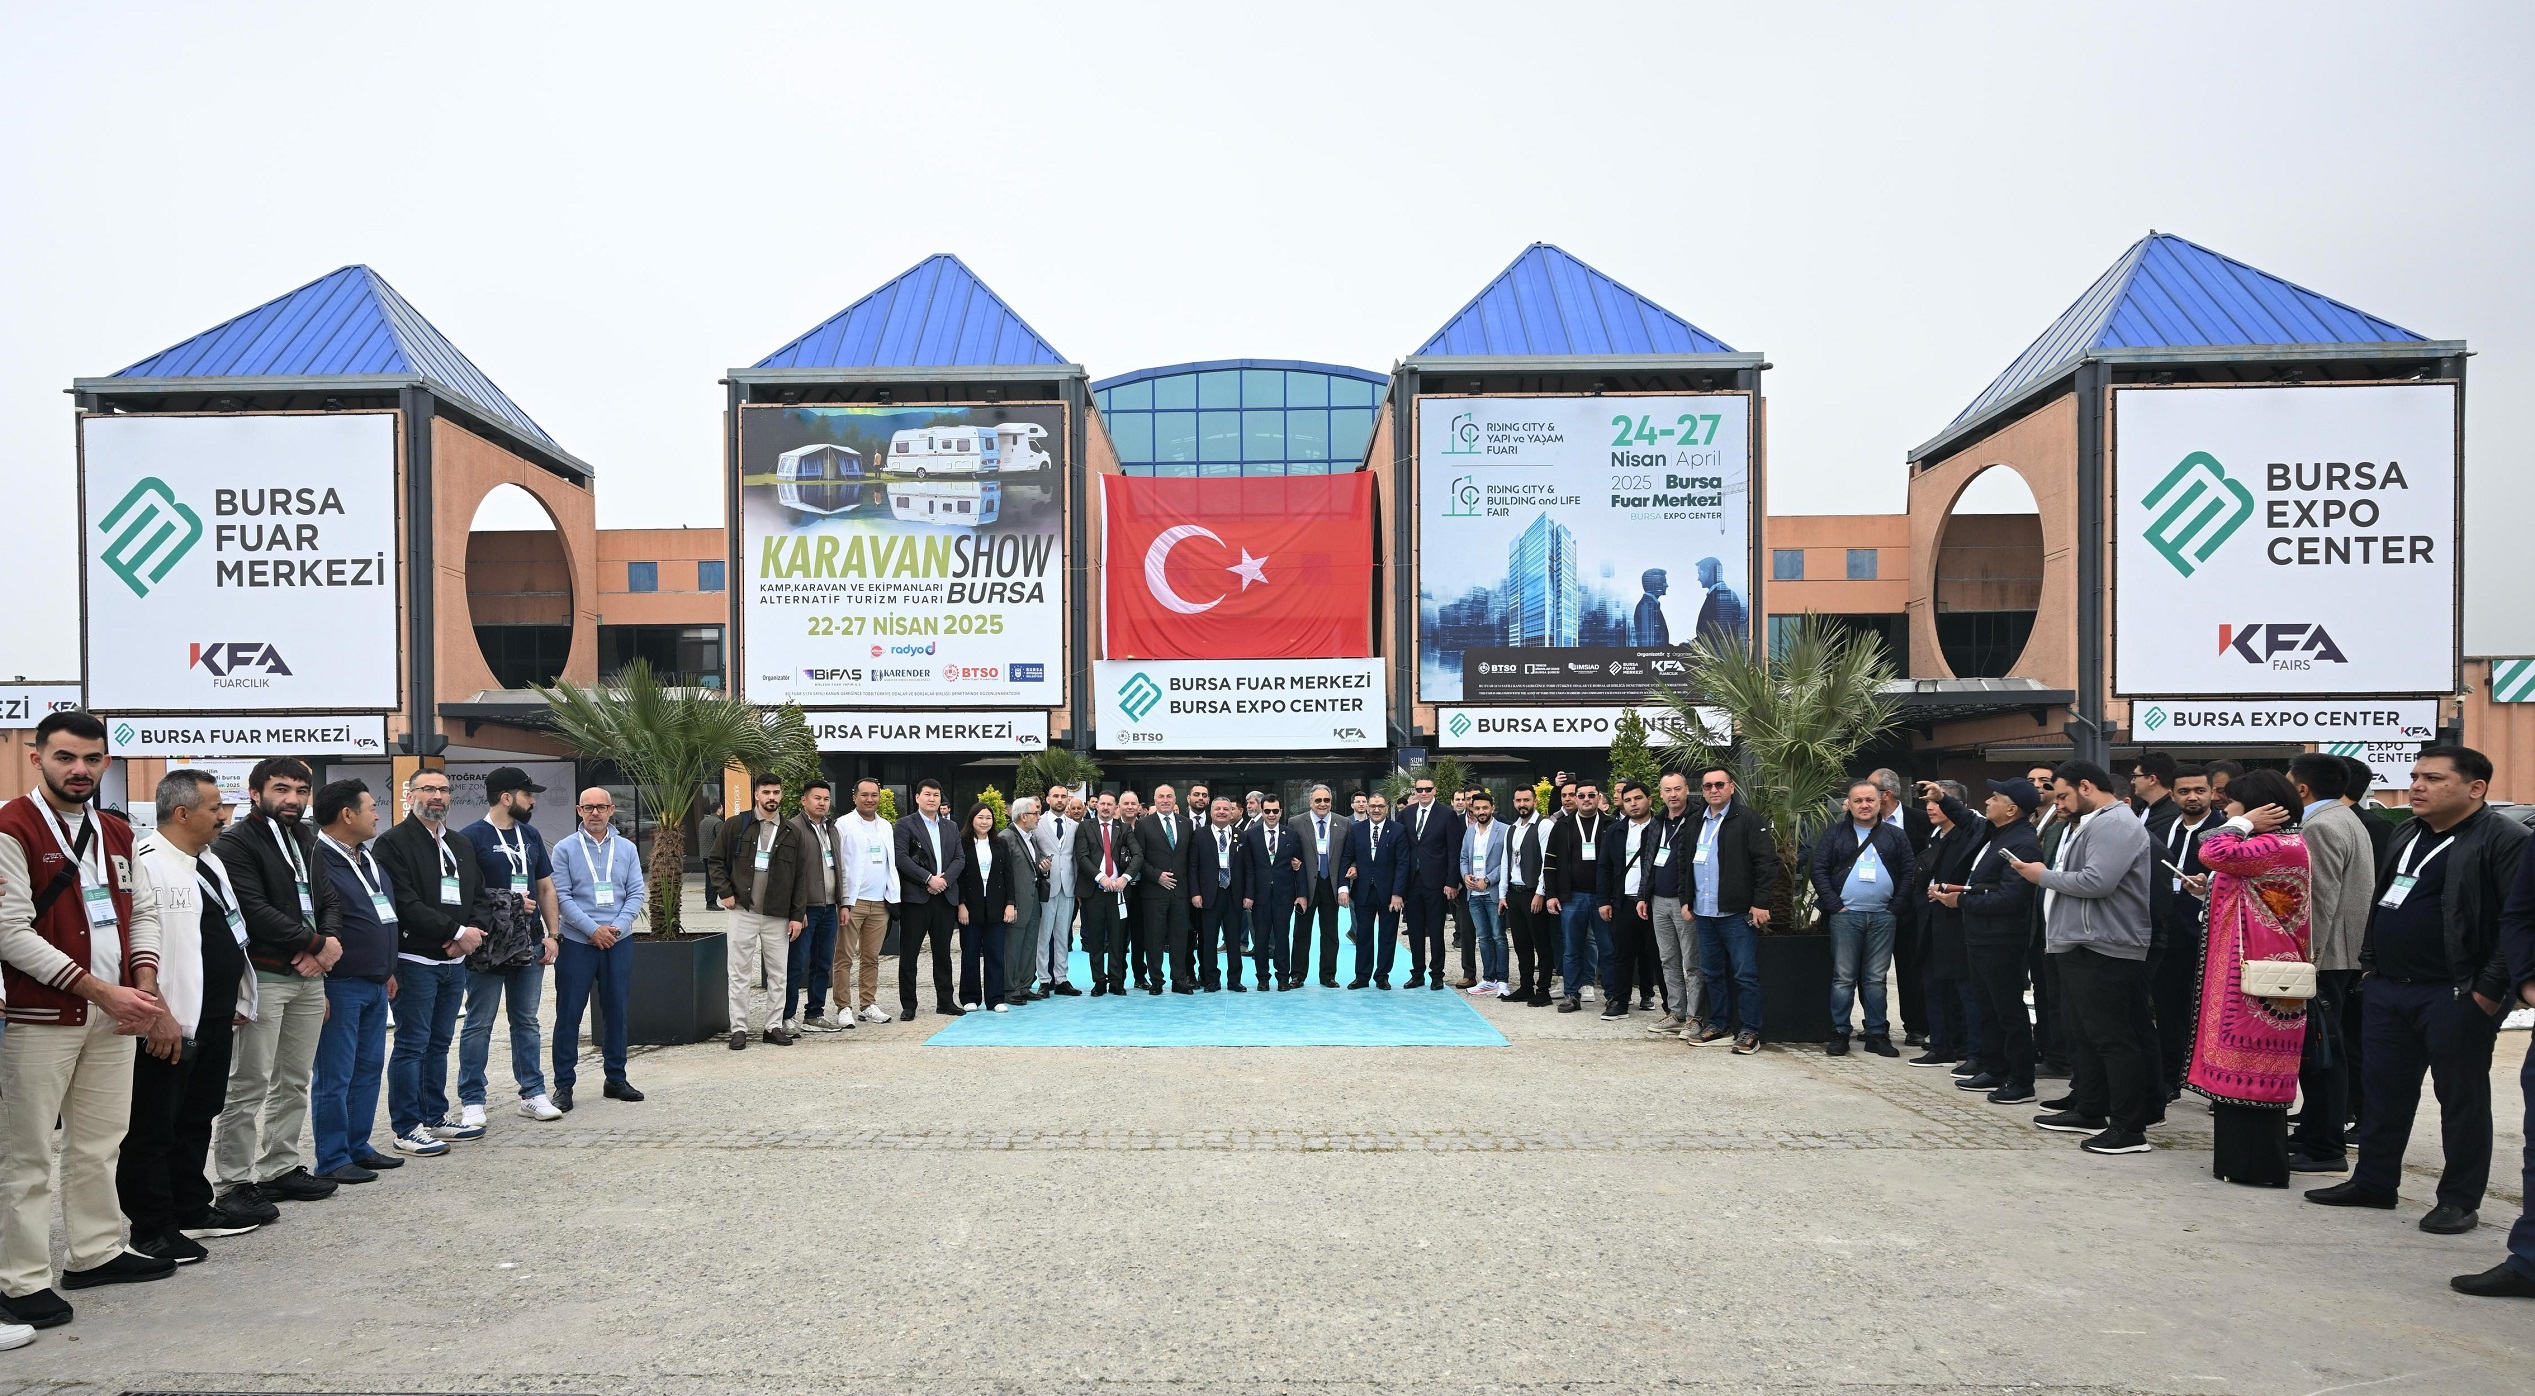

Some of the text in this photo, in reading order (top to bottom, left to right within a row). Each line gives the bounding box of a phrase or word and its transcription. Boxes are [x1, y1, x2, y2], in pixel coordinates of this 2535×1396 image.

[1487, 422, 1555, 432] RISING CITY &
[1611, 414, 1722, 447] 24-27
[1487, 434, 1511, 443] YAPI
[1527, 434, 1564, 446] YAŞAM
[1487, 446, 1518, 455] FUARI
[1611, 450, 1721, 470] Nisan April
[1611, 474, 1722, 491] 2025 Bursa
[2267, 461, 2409, 491] BURSA
[1487, 485, 1555, 494] RISING CITY &
[215, 488, 345, 515] BURSA
[1487, 496, 1581, 505] BUILDING and LIFE
[1611, 491, 1722, 508] Fuar Merkezi
[1487, 508, 1510, 517] FAIR
[2267, 499, 2380, 528] EXPO
[216, 524, 319, 551] FUAR
[2267, 535, 2434, 565] CENTER
[216, 552, 384, 587] MERKEZİ
[850, 583, 864, 593] VE
[868, 582, 943, 592] EKİPMANLARI
[947, 581, 1044, 604] BURSA
[760, 594, 943, 604] ALTERNATİF TURİZM FUARI
[808, 611, 1004, 636] 22-27 NİSAN 2025
[2218, 623, 2349, 664] KFA
[190, 643, 293, 676] KFA
[1652, 661, 1686, 672] KFA
[2273, 660, 2311, 670] FAIRS
[884, 669, 930, 677] KARENDER
[962, 668, 999, 678] BTSO
[213, 679, 270, 688] FUARCILIK
[1170, 672, 1371, 691] BURSA FUAR MERKEZİ
[0, 695, 29, 719] Zİ
[1170, 698, 1363, 714] BURSA EXPO CENTER
[1478, 717, 1692, 733] BURSA EXPO CNTE
[2173, 711, 2400, 726] BURSA EXPO CENTER
[141, 725, 350, 744] BURSA FUAR MERKEZİ
[809, 721, 1012, 740] URSA FUAR MERKEZİ
[1132, 733, 1163, 741] BTSO
[1333, 728, 1366, 739] KFA
[2400, 726, 2432, 736] KFA
[354, 738, 379, 748] KFA
[1016, 735, 1041, 744] KFA
[446, 773, 488, 781] TOĞRAF
[2372, 773, 2389, 783] FA
[400, 781, 411, 820] selen
